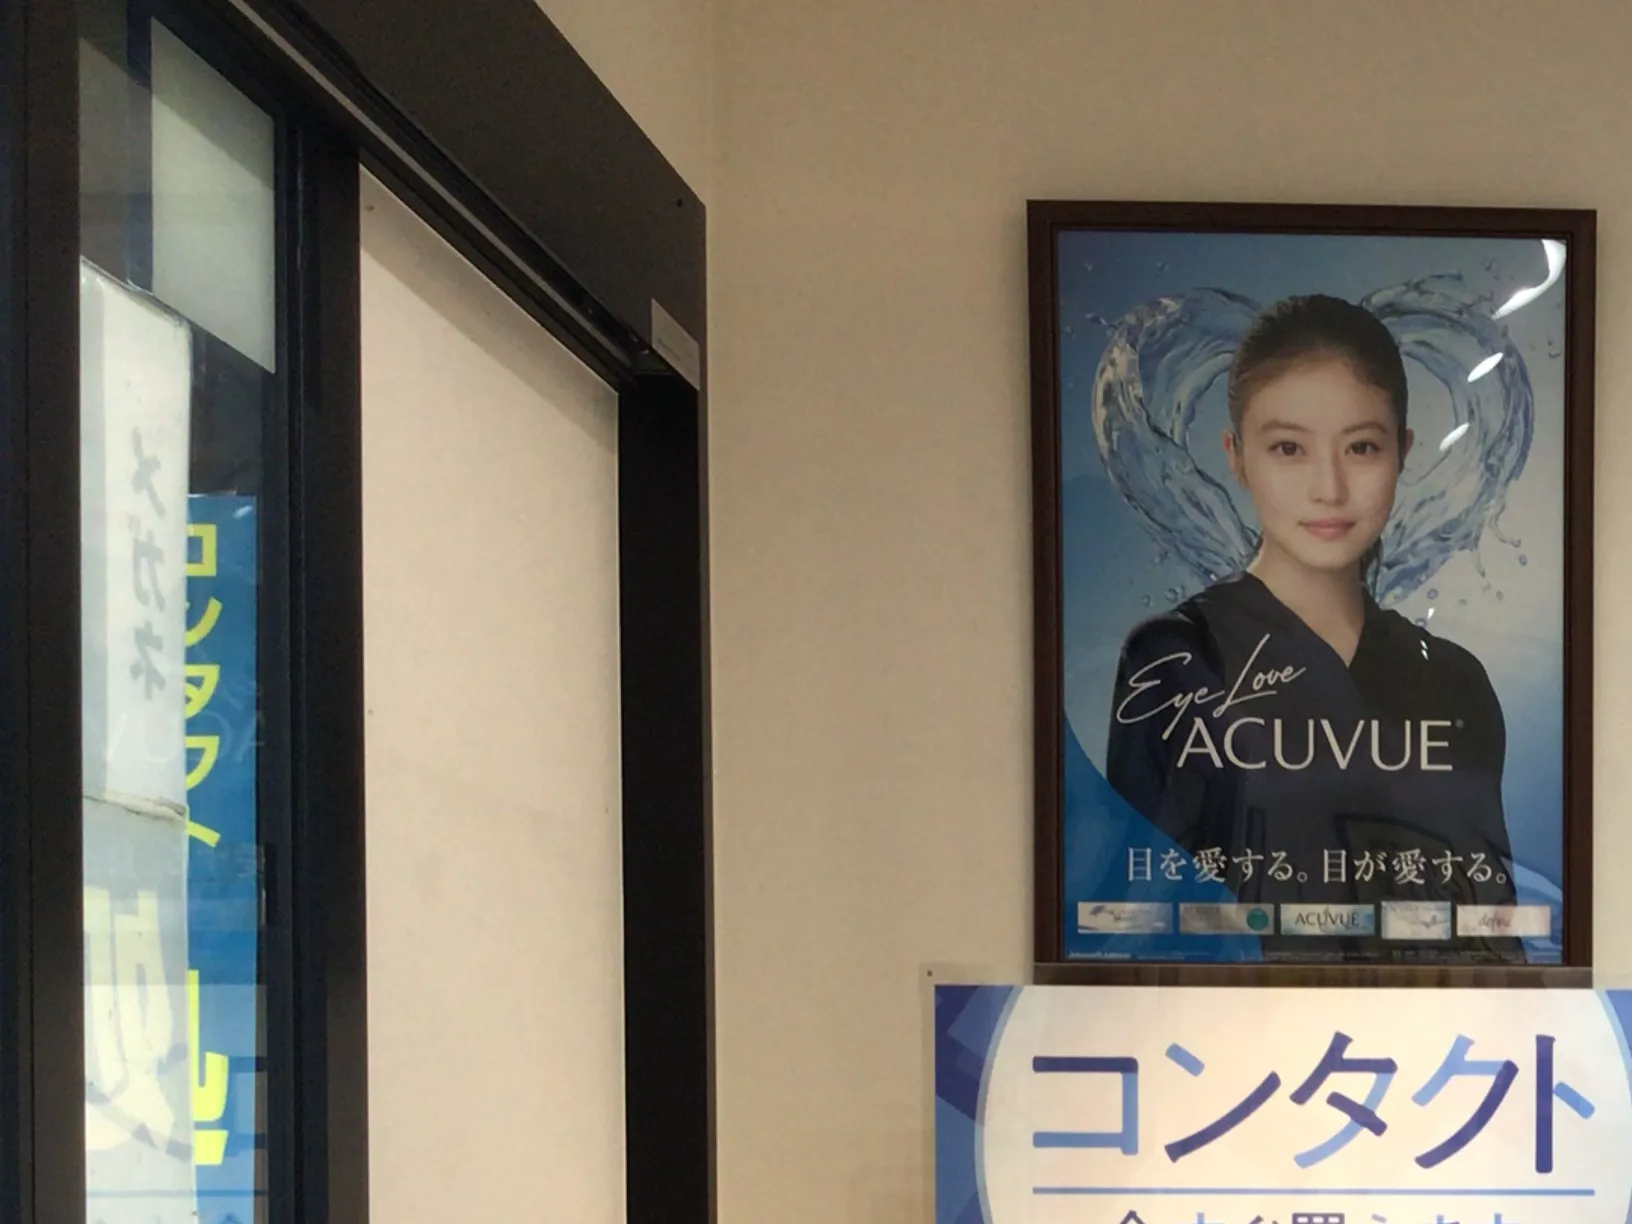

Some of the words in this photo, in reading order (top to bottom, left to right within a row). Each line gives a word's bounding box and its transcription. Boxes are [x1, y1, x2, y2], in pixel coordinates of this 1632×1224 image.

[1117, 652, 1227, 739] Eye
[1213, 633, 1306, 718] Love
[1177, 717, 1453, 771] ACUVUE
[1126, 848, 1508, 885] 目を愛する。目が愛する。
[1294, 912, 1360, 927] ACUVUE
[1031, 1030, 1595, 1175] コンタクト
